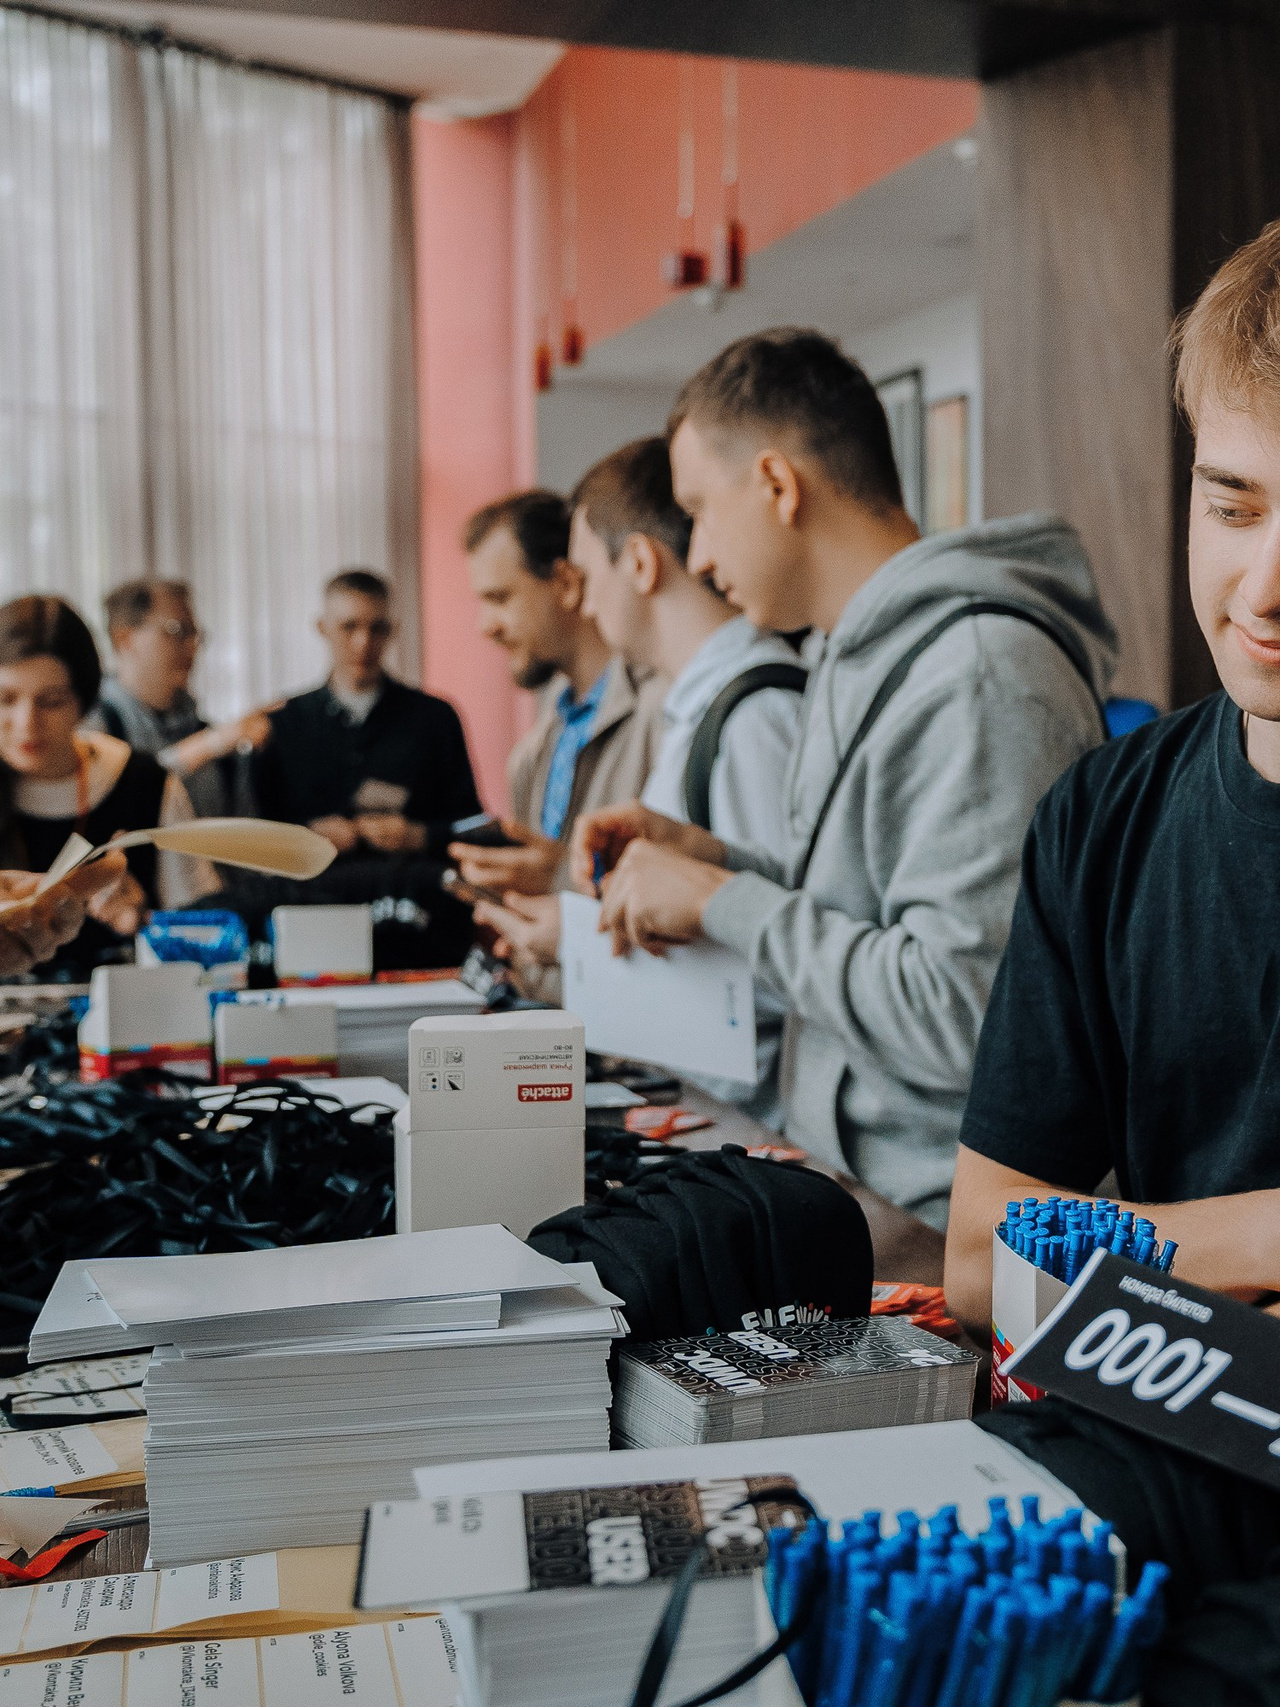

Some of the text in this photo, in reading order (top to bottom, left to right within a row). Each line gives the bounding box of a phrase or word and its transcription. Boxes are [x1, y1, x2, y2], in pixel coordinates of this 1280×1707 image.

[521, 1086, 570, 1101] attaché
[1118, 1275, 1213, 1324] номера билетов
[723, 1328, 805, 1360] USER
[1064, 1308, 1233, 1413] 0001
[98, 1577, 120, 1607] Самарина
[117, 1575, 140, 1611] Александра
[66, 1657, 89, 1692] Кирилл
[200, 1642, 224, 1689] Gela Singer
[330, 1631, 358, 1695] Alyona Volkova
